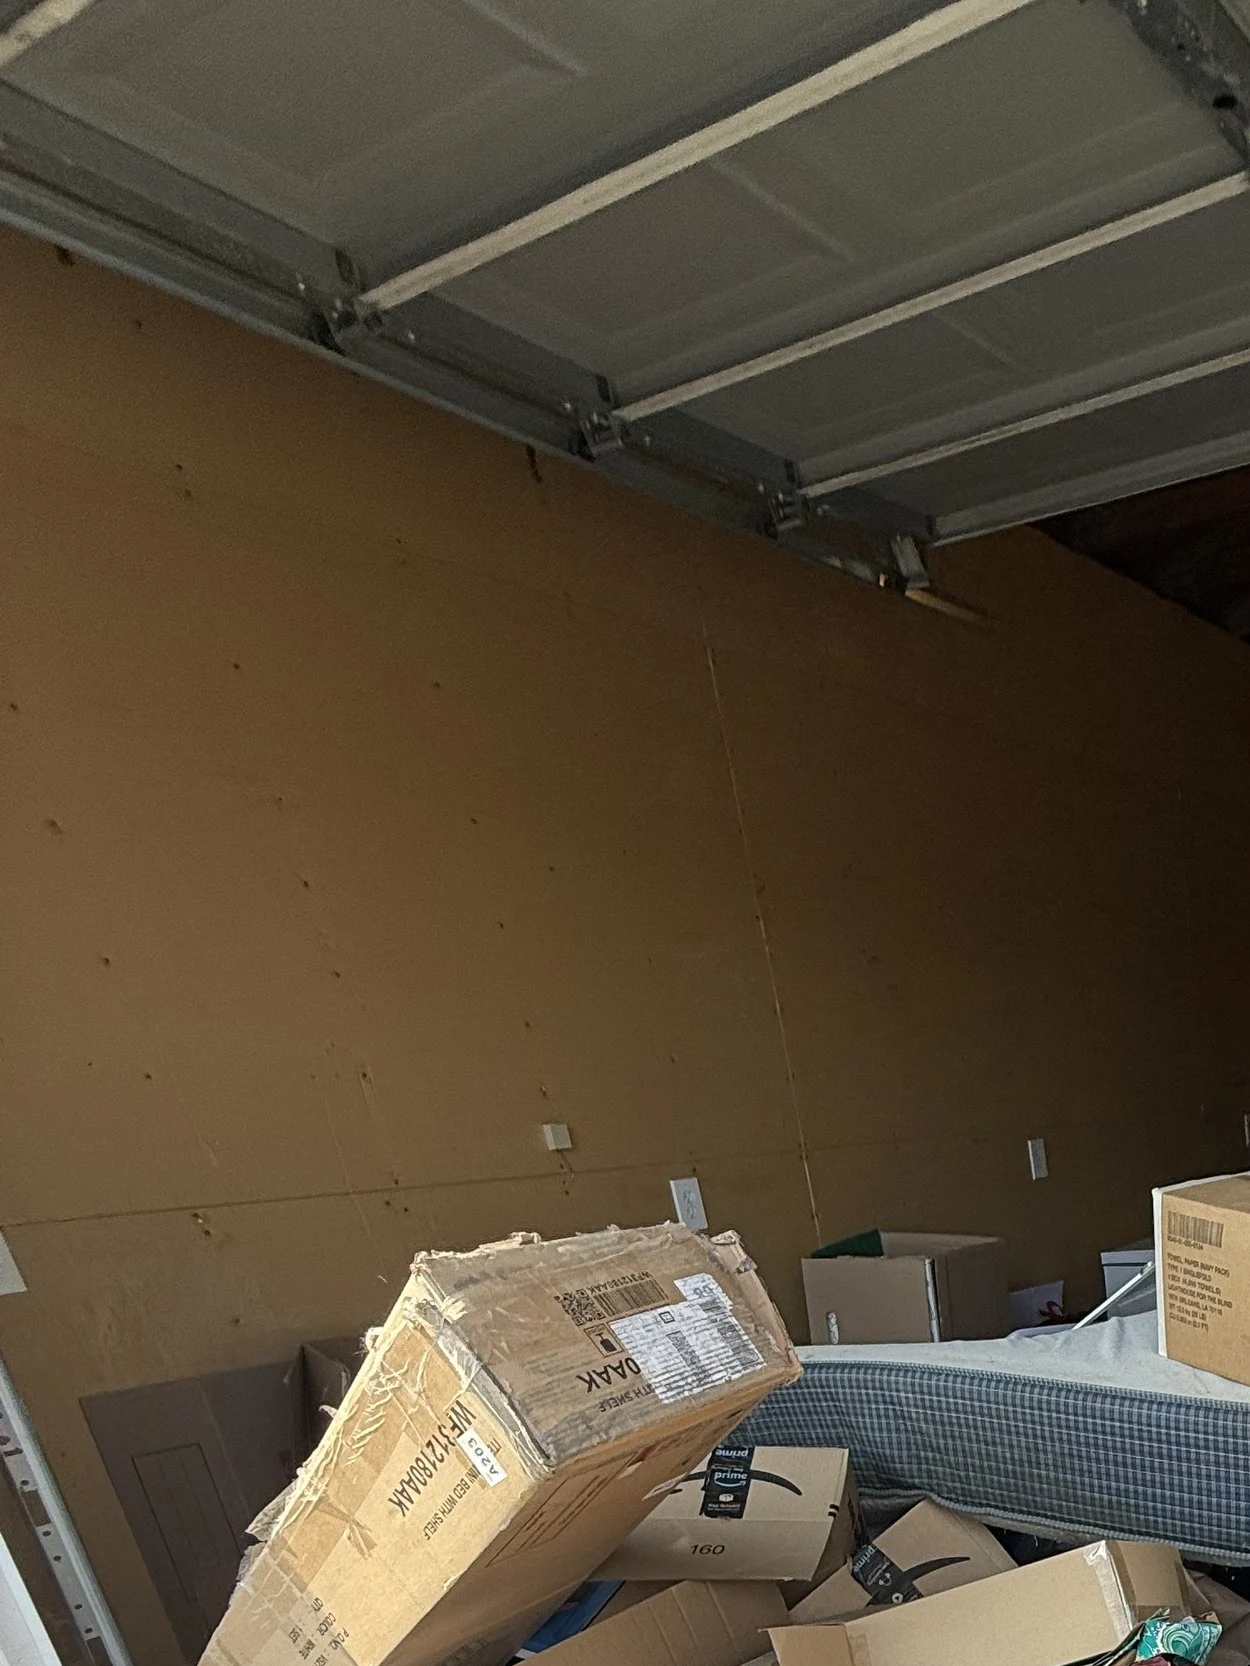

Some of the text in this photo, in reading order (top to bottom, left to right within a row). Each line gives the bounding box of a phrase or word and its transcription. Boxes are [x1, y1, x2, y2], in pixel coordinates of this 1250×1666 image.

[388, 1400, 477, 1517] WF312180AAK
[467, 1437, 499, 1475] A203
[715, 1447, 749, 1458] prime
[453, 1478, 470, 1499] BED
[714, 1471, 748, 1482] prime
[439, 1494, 459, 1518] WITH
[423, 1512, 444, 1541] SHELF
[691, 1544, 726, 1555] 160
[852, 1545, 876, 1573] prime
